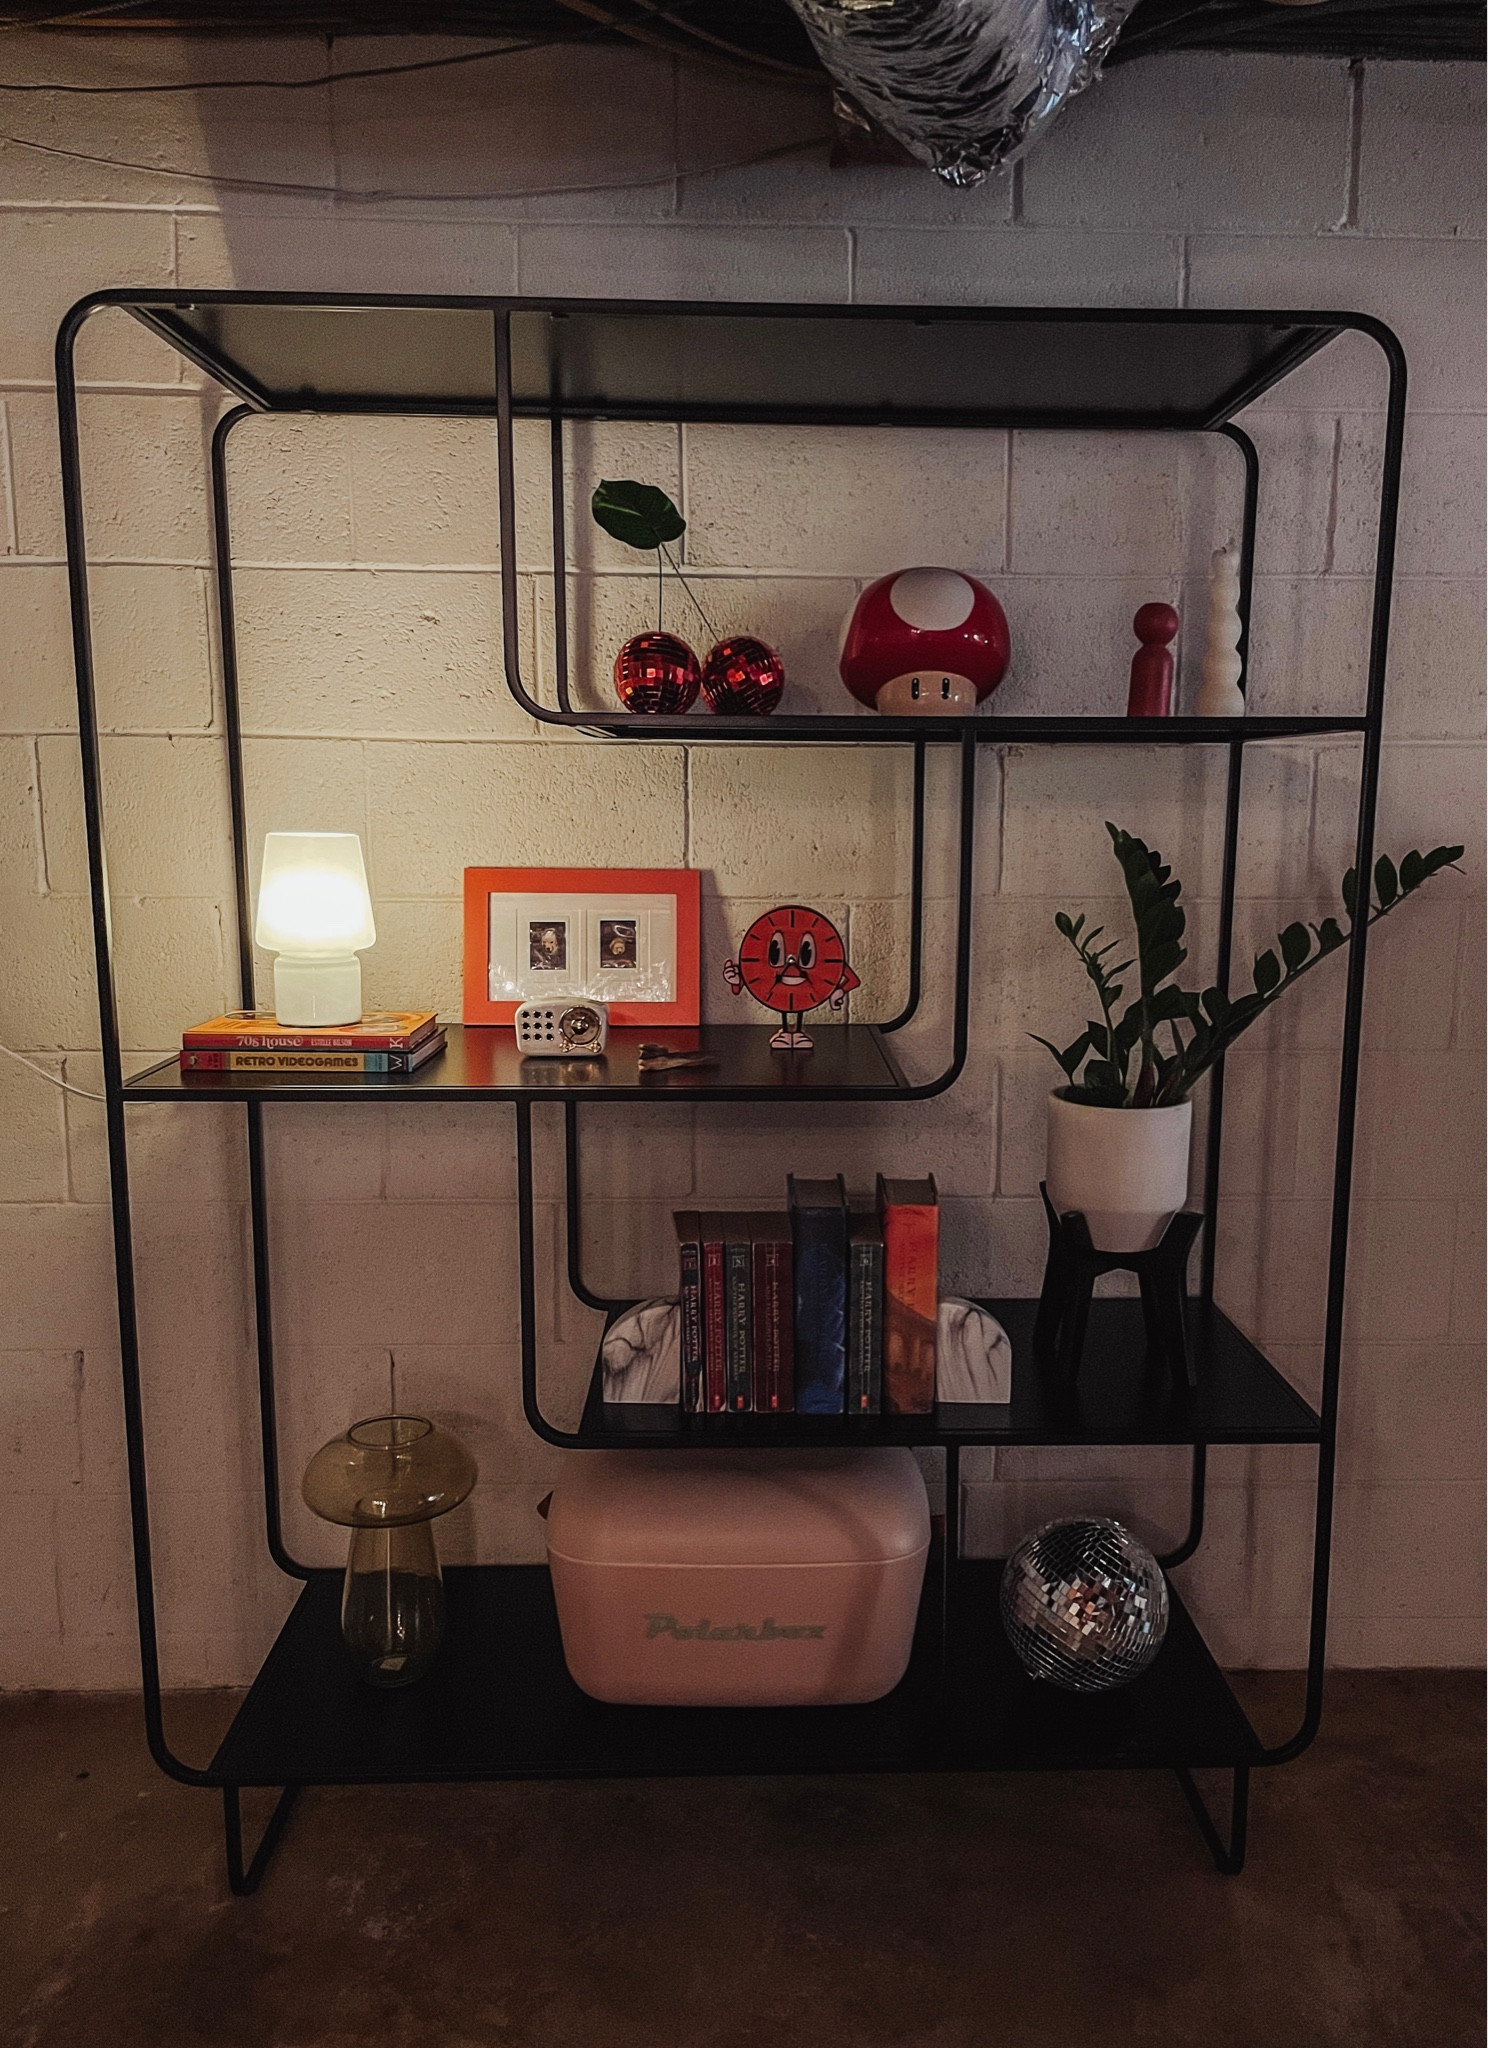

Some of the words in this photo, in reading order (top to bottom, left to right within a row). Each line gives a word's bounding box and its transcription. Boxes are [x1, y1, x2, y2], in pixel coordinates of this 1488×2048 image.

[236, 1036, 259, 1047] 70s
[262, 1035, 304, 1049] house
[236, 1057, 275, 1066] RETRO
[278, 1057, 358, 1067] VIDEOGAMES
[390, 1037, 403, 1049] K
[714, 1281, 722, 1324] HARRY
[738, 1283, 746, 1327] HARRY
[864, 1281, 872, 1323] HARRY
[714, 1329, 722, 1371] POTTER
